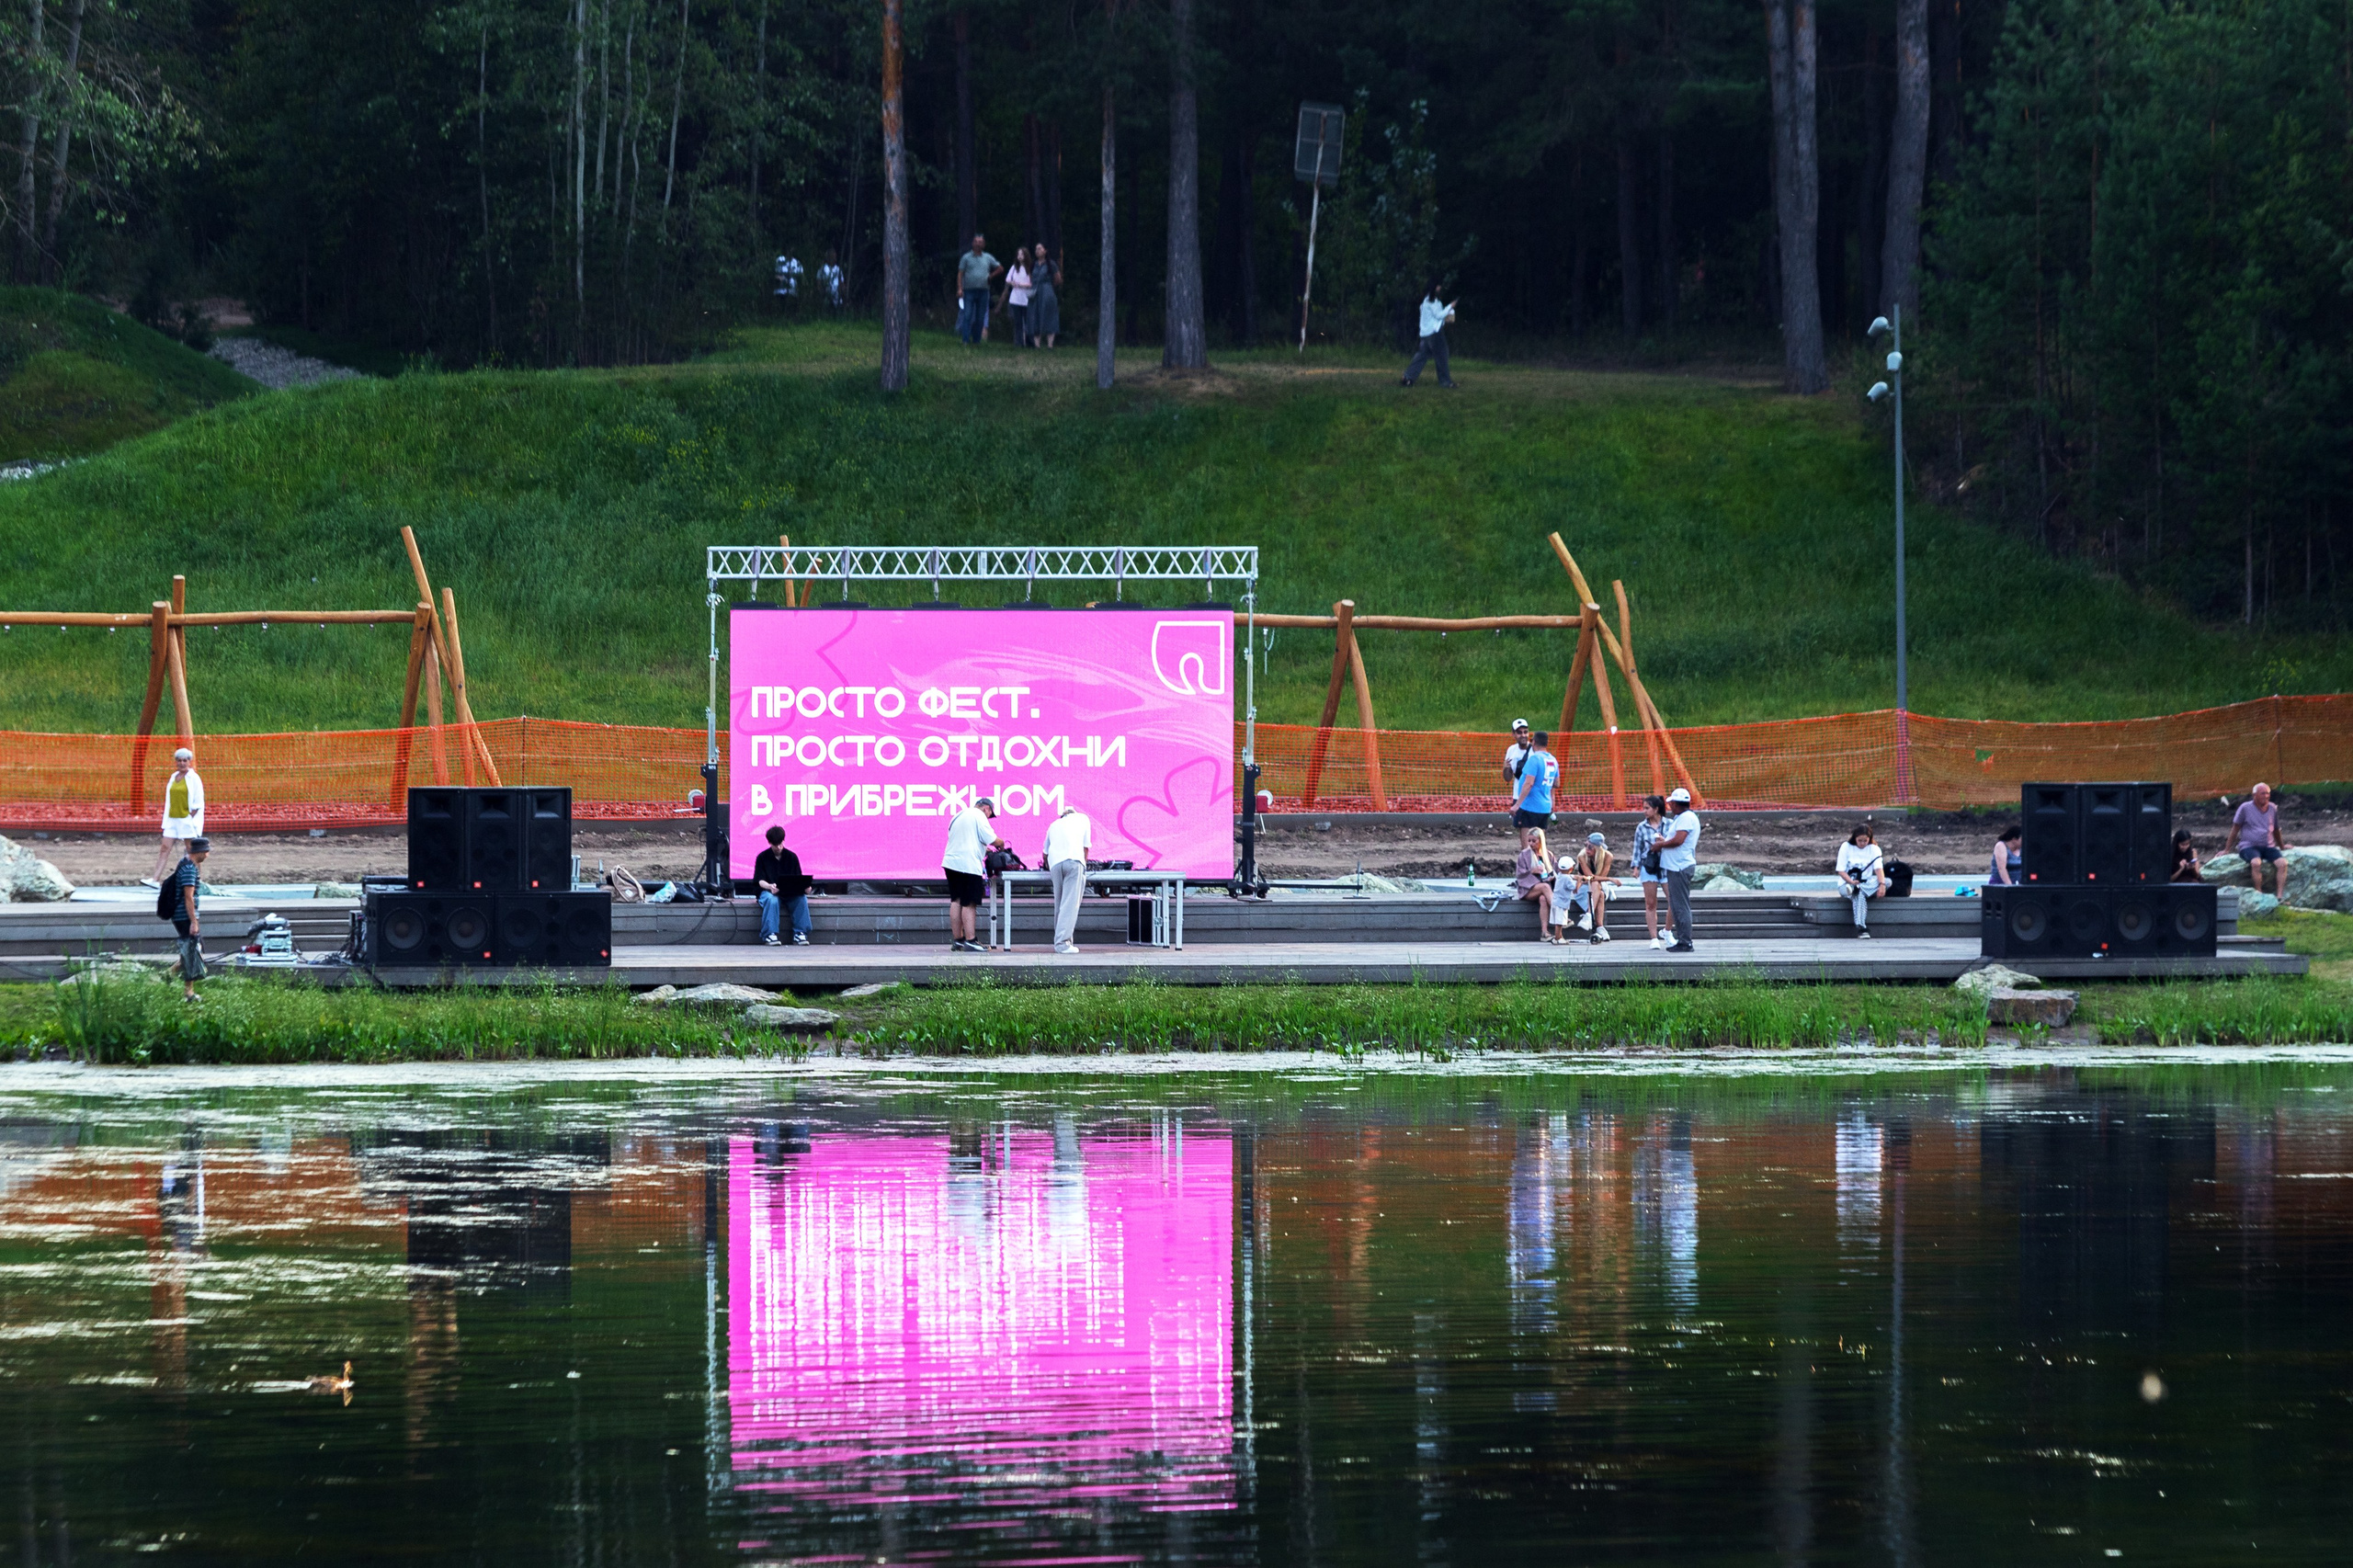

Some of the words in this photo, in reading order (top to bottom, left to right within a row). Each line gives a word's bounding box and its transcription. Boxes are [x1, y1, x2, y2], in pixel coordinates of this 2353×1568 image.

[751, 687, 905, 719] ПРОСТО
[918, 687, 1040, 719] ФЕСТ.
[751, 735, 905, 767] ПРОСТО
[918, 735, 1126, 772] ОТДОХНИ
[751, 785, 773, 817] В
